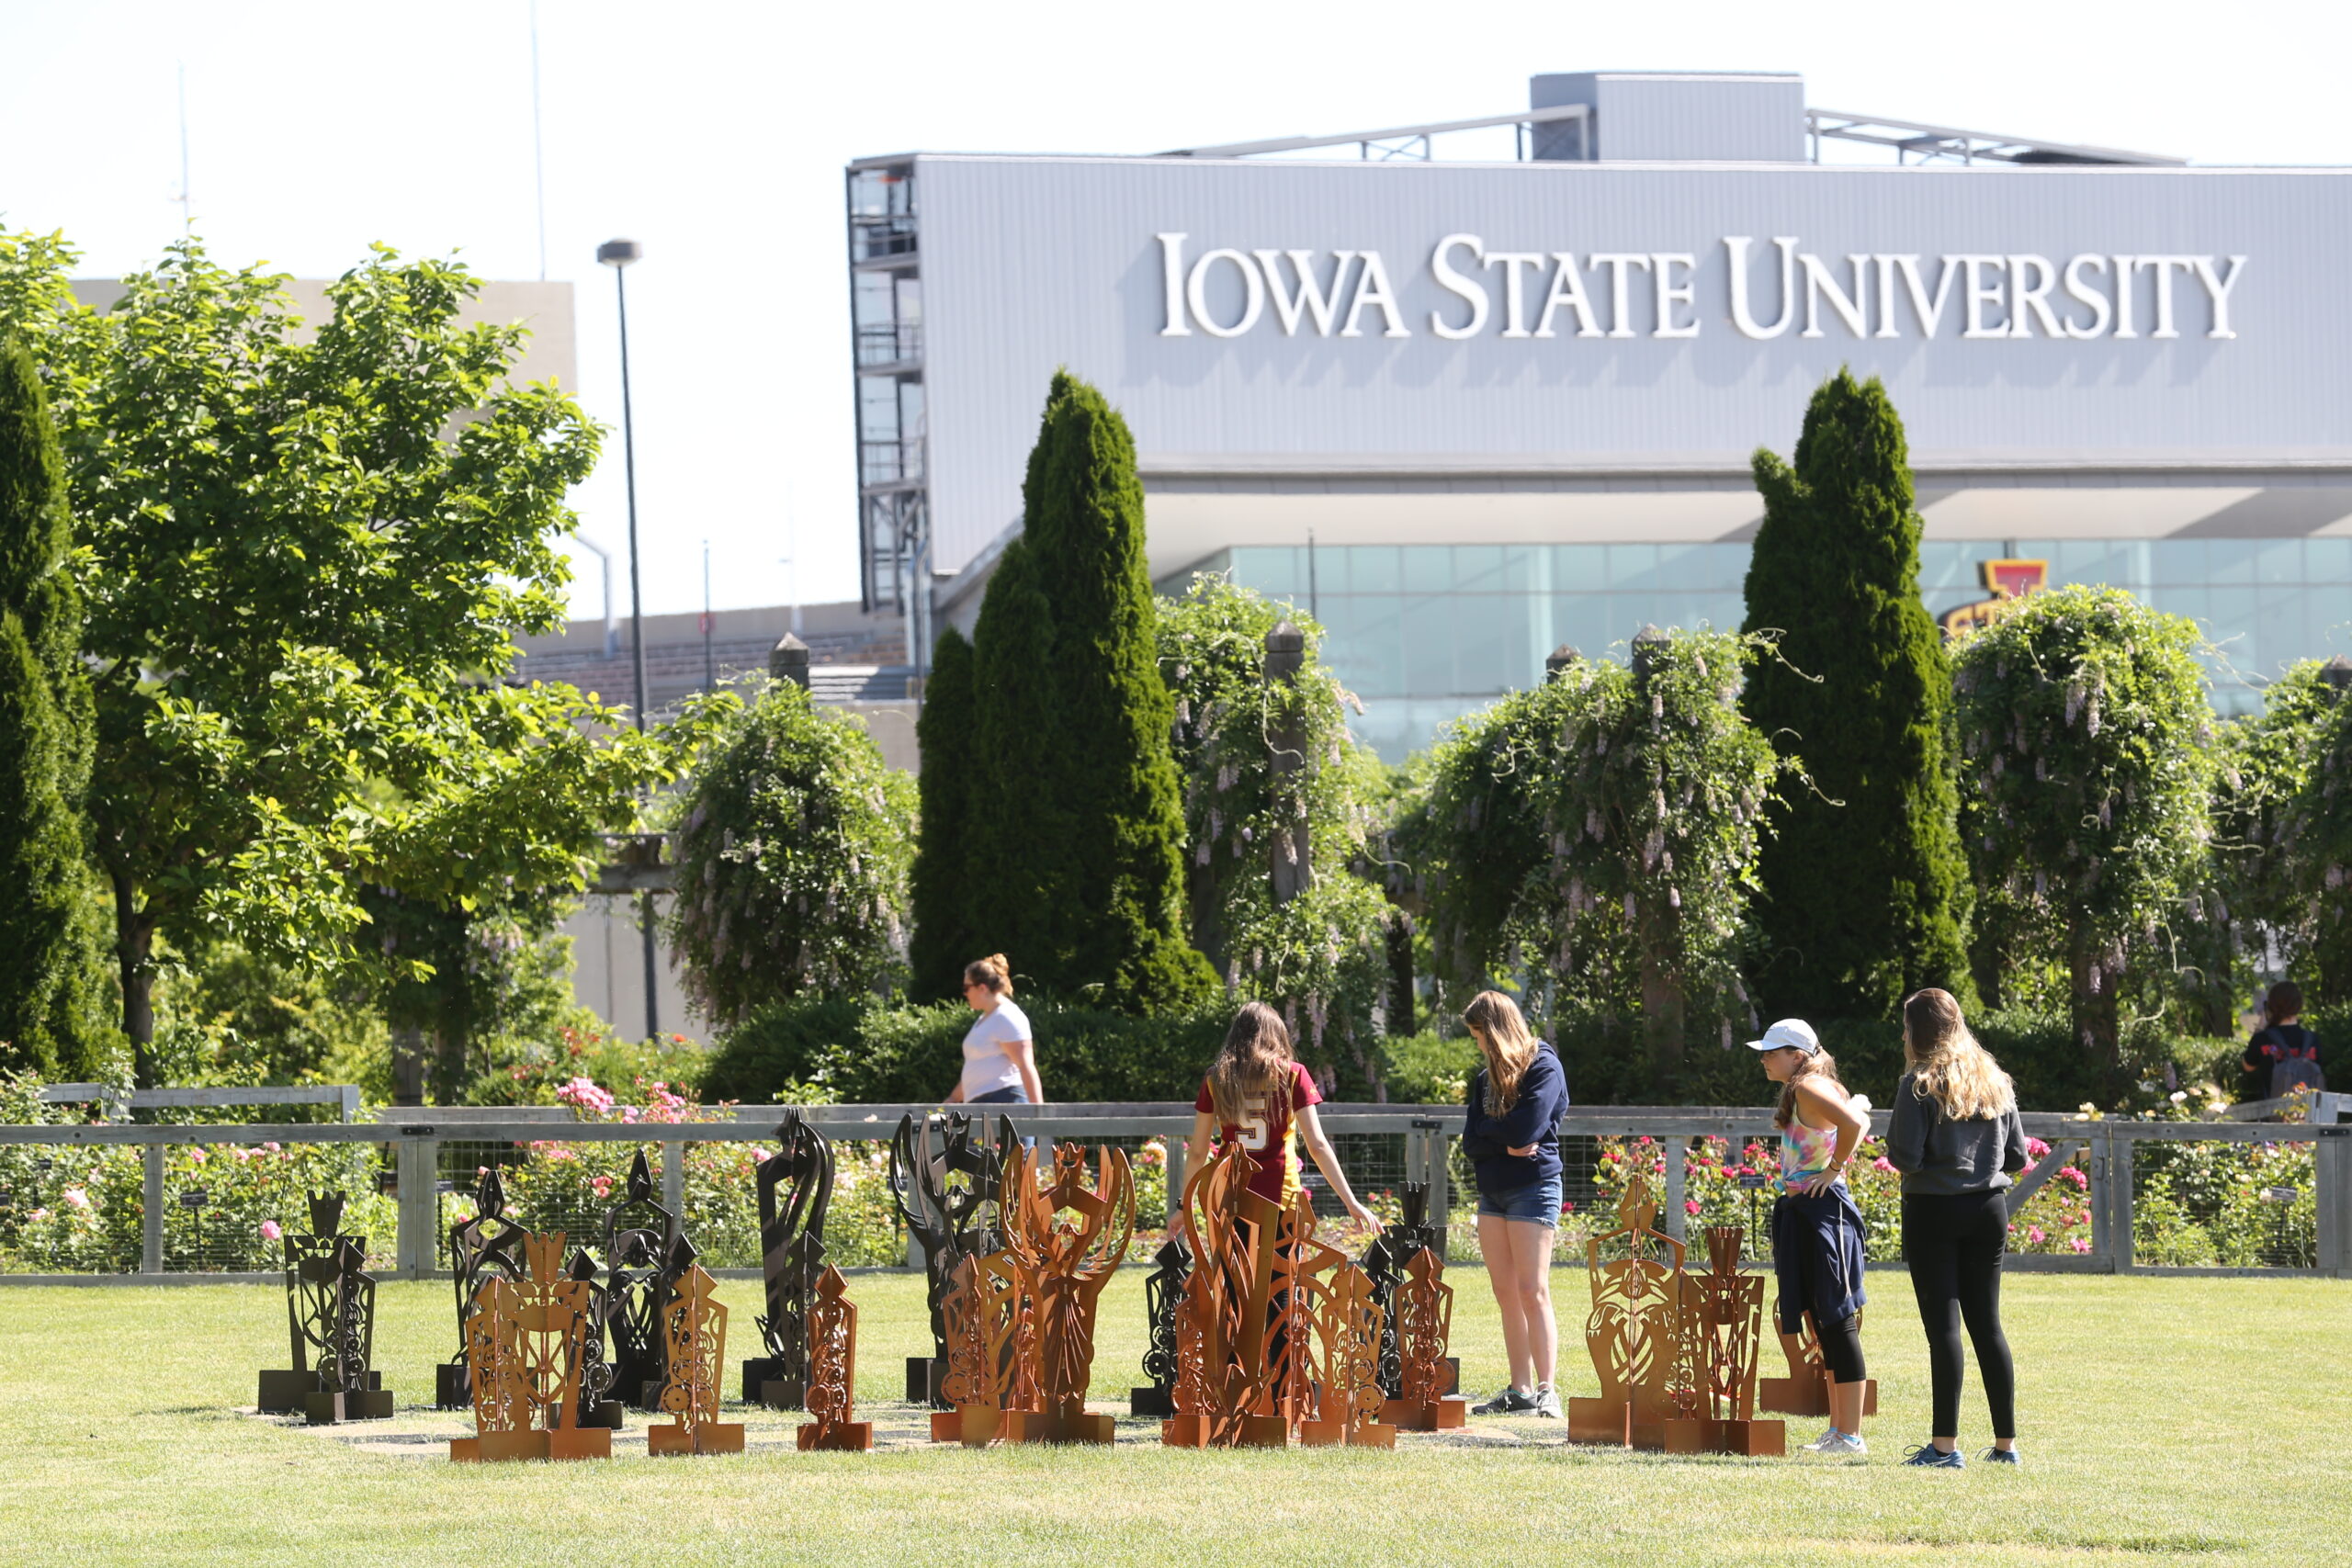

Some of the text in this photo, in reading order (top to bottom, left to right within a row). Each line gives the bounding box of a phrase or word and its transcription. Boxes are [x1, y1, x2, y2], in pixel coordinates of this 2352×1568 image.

[1157, 232, 2247, 339] IOWA STATE UNIVERSITY
[1235, 1096, 1269, 1152] 5
